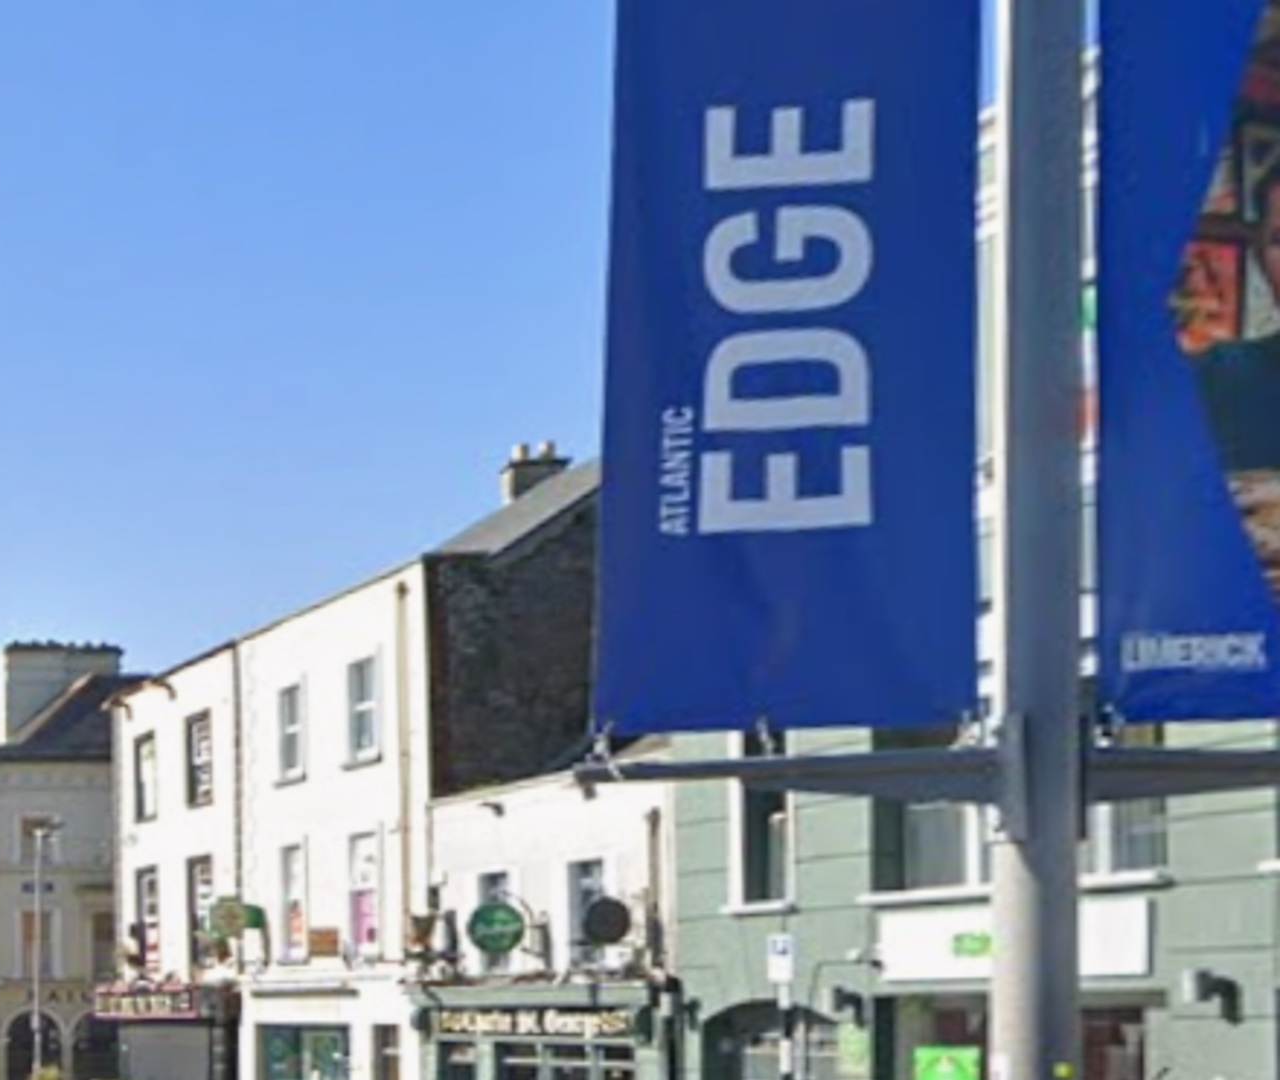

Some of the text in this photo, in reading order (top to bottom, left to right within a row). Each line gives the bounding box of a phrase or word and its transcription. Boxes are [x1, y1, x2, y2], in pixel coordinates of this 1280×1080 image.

[697, 97, 876, 535] EDGE
[659, 406, 693, 536] ATLANTIC
[1120, 632, 1266, 672] LIMERICK
